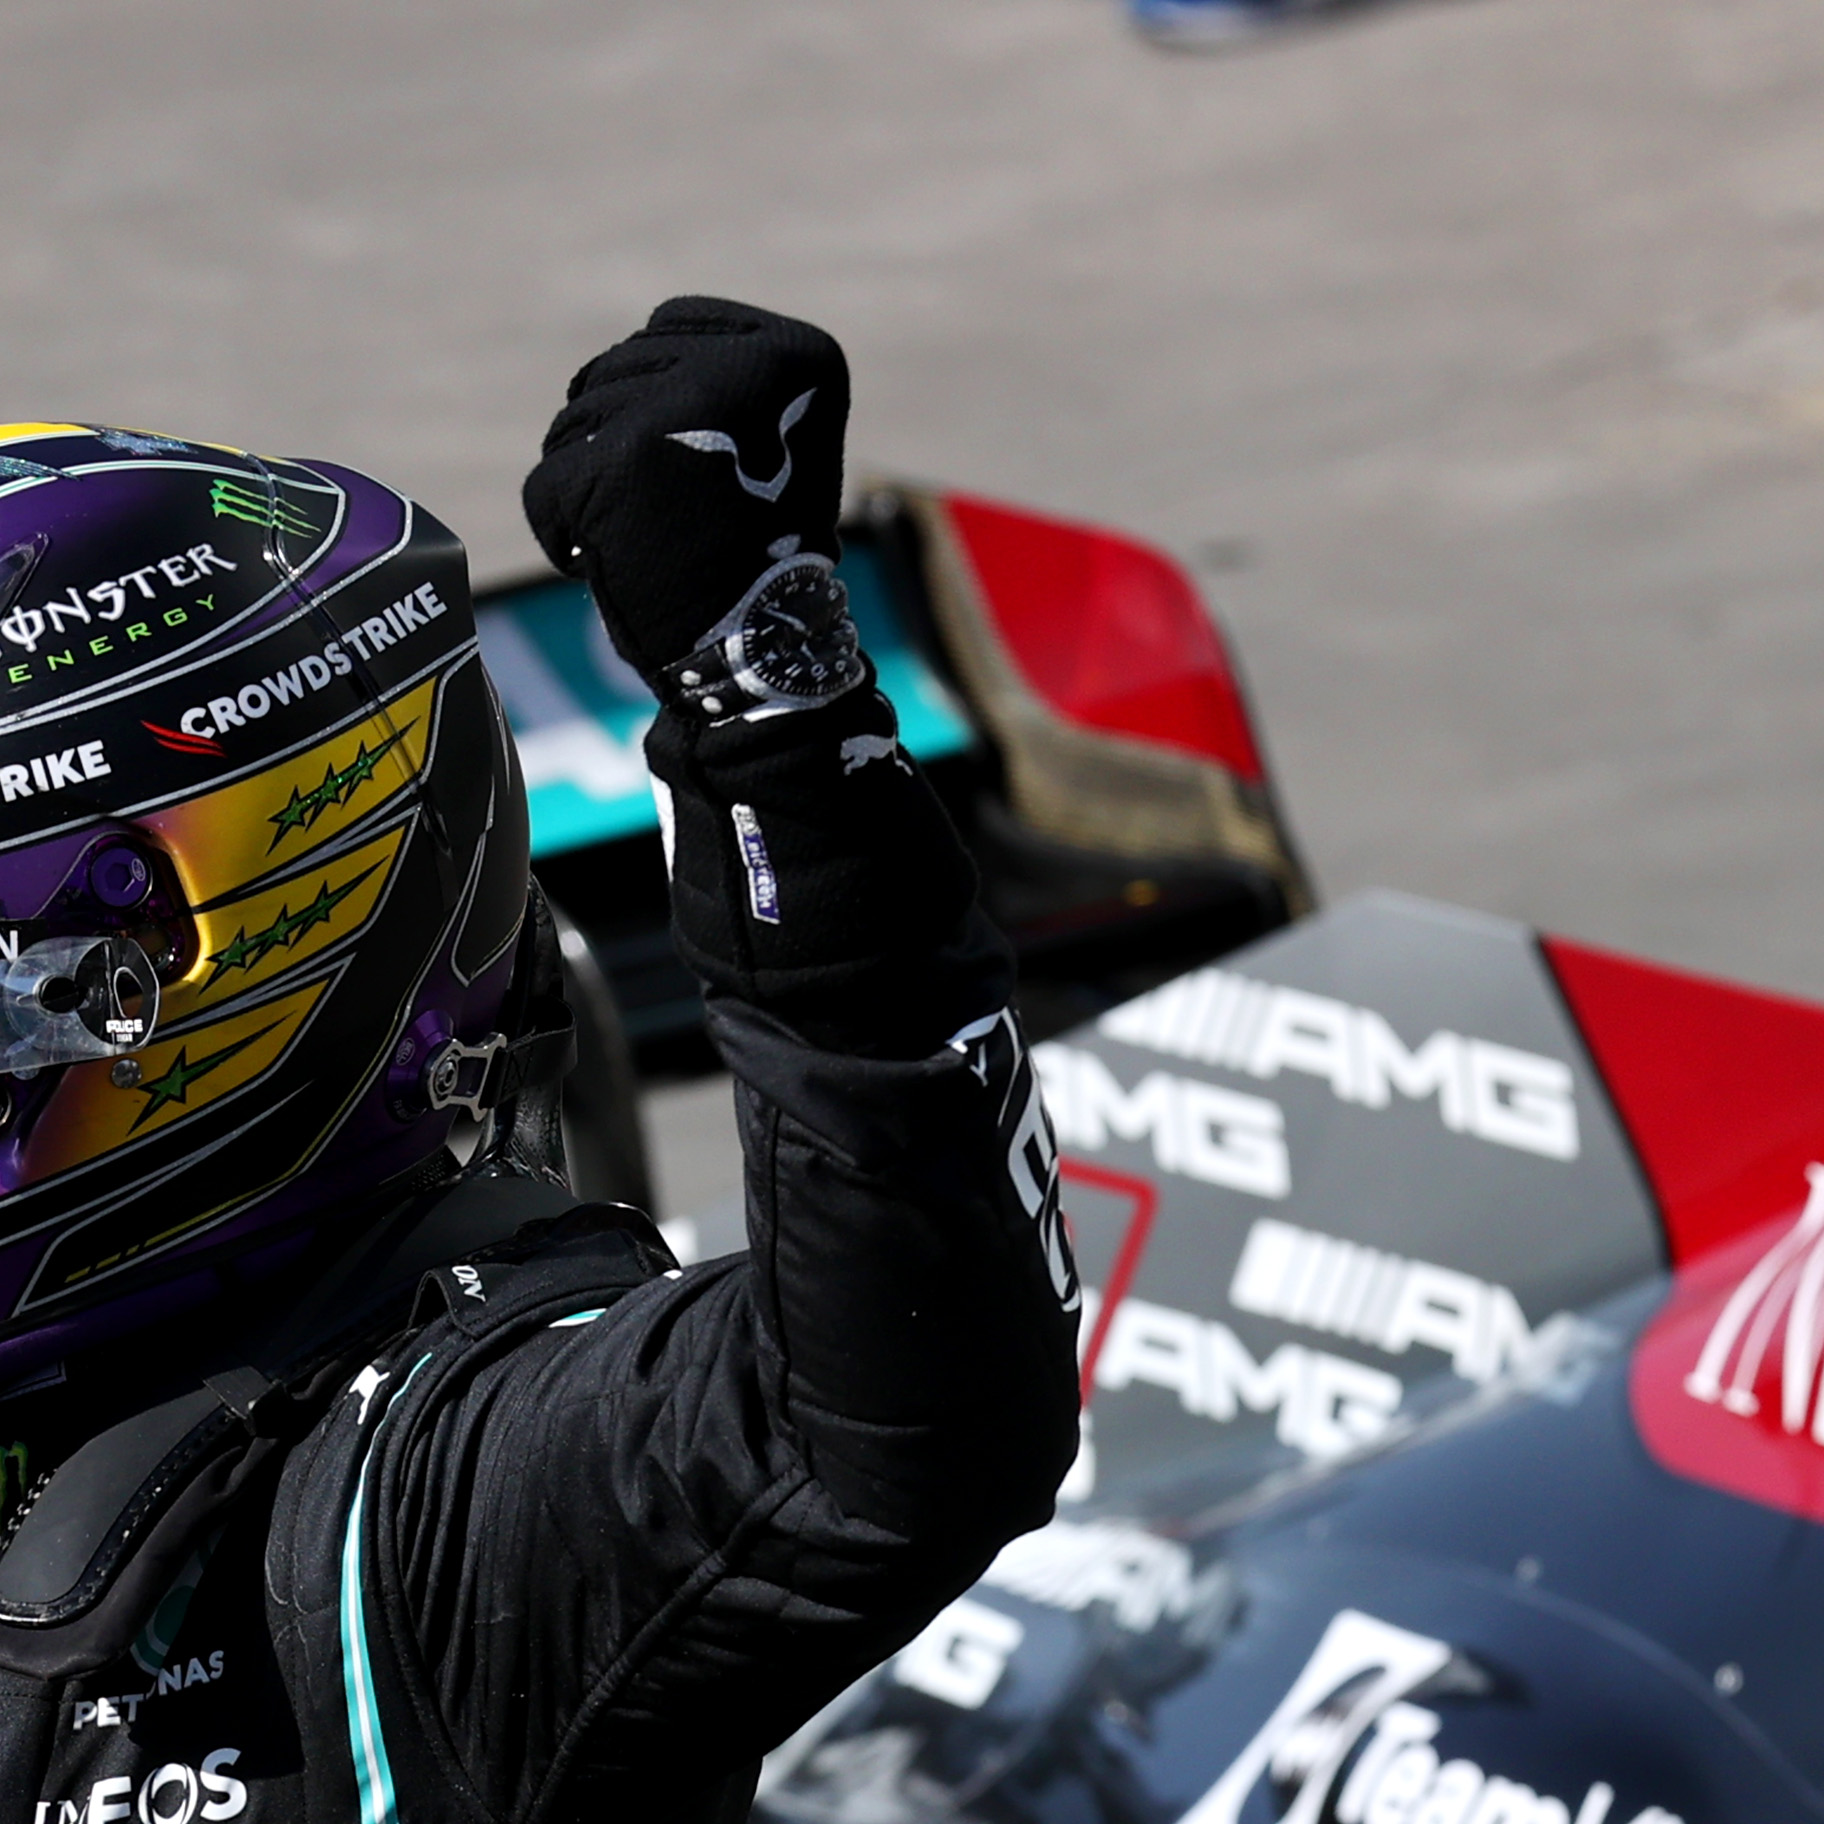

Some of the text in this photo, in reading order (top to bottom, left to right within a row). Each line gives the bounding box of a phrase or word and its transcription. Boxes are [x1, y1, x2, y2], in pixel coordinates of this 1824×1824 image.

[7, 594, 215, 683] ENERGY
[179, 582, 447, 740] CROWDSTRIKE
[1251, 980, 1581, 1162] AMG
[73, 1650, 224, 1730] PETNAS
